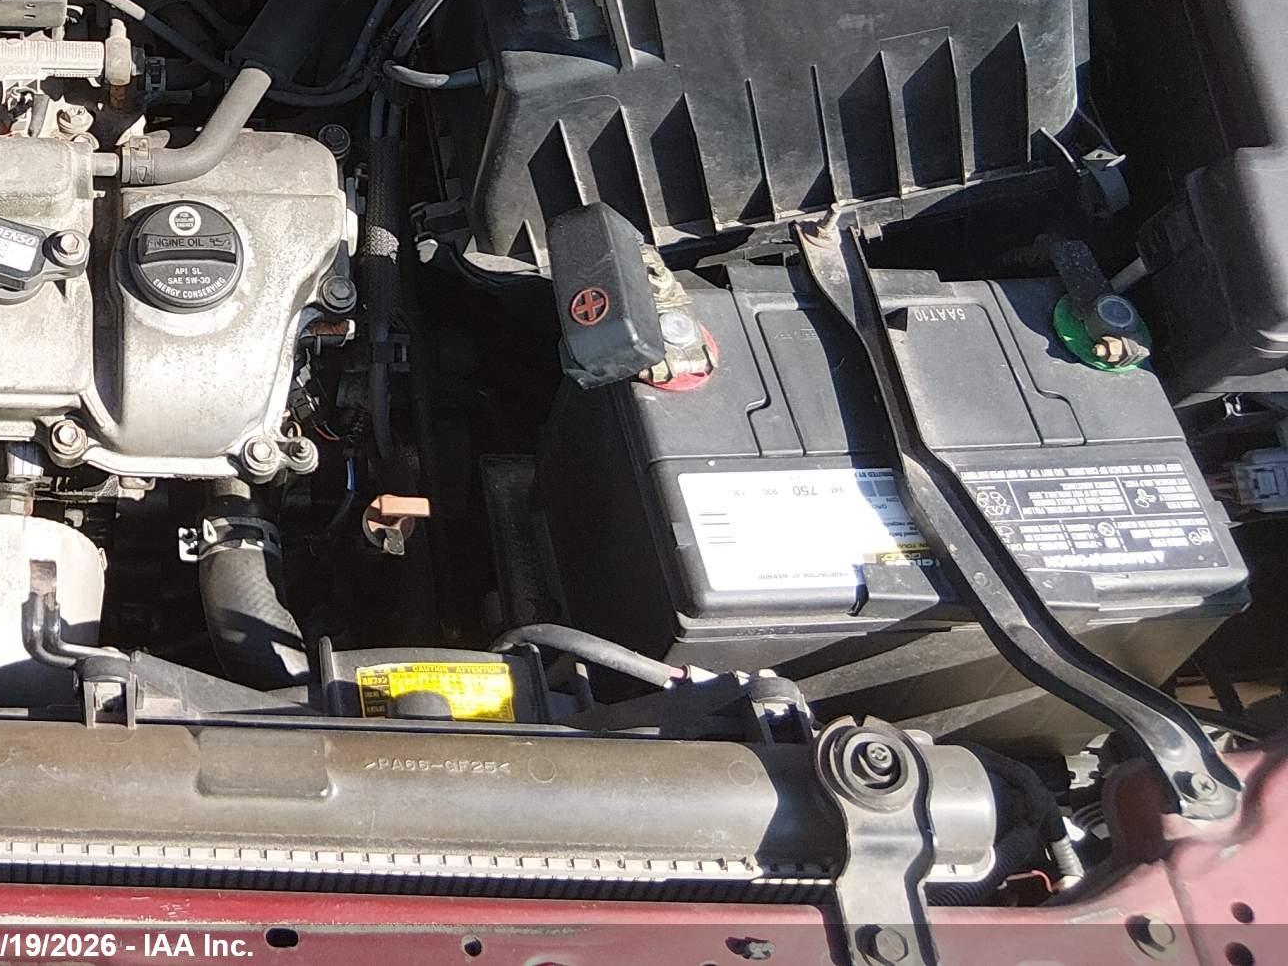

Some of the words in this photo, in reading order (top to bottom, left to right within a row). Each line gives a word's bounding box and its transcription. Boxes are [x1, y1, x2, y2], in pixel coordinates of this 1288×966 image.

[148, 238, 185, 247] ENGINE
[187, 238, 204, 247] OIL
[175, 267, 188, 275] API
[191, 267, 202, 275] SL
[185, 276, 211, 284] 5W-30
[152, 278, 181, 297] ENERGY
[182, 276, 227, 299] CONSERVING
[792, 485, 818, 496] 750
[412, 665, 449, 674] CAUTION
[455, 665, 502, 674] ATTENTION
